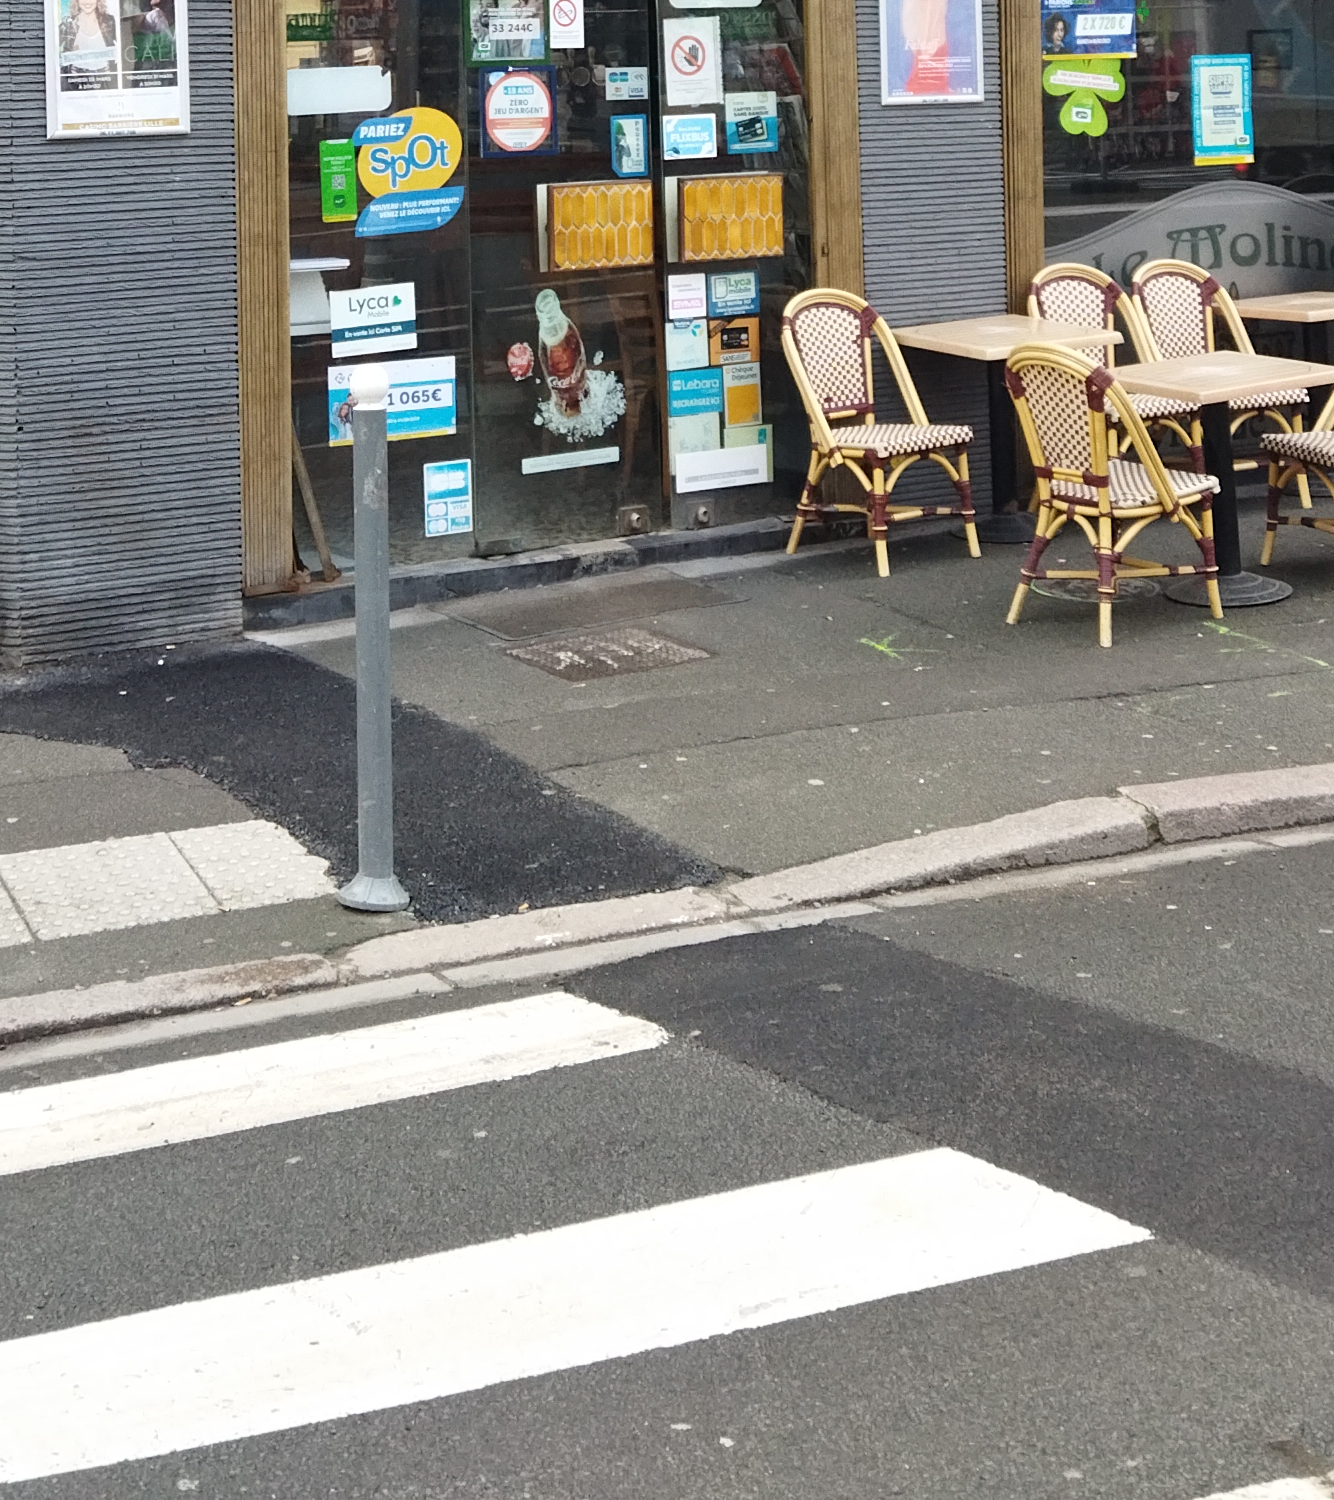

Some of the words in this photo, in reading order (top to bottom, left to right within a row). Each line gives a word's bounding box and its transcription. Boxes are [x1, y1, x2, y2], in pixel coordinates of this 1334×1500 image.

[491, 23, 505, 34] 33
[124, 45, 176, 62] CALI
[516, 86, 534, 95] ANS
[508, 107, 544, 115] D'ARGENT
[359, 123, 405, 139] PARIEZ
[670, 131, 710, 144] FLIXBUS
[370, 202, 398, 212] NOUVEAU
[379, 210, 399, 219] VENEZ
[728, 277, 752, 288] Lyca
[348, 295, 389, 314] Lyca
[367, 310, 390, 319] Mobile
[731, 365, 753, 373] Chèque
[682, 379, 720, 390] Lebara
[399, 388, 442, 405] 065€
